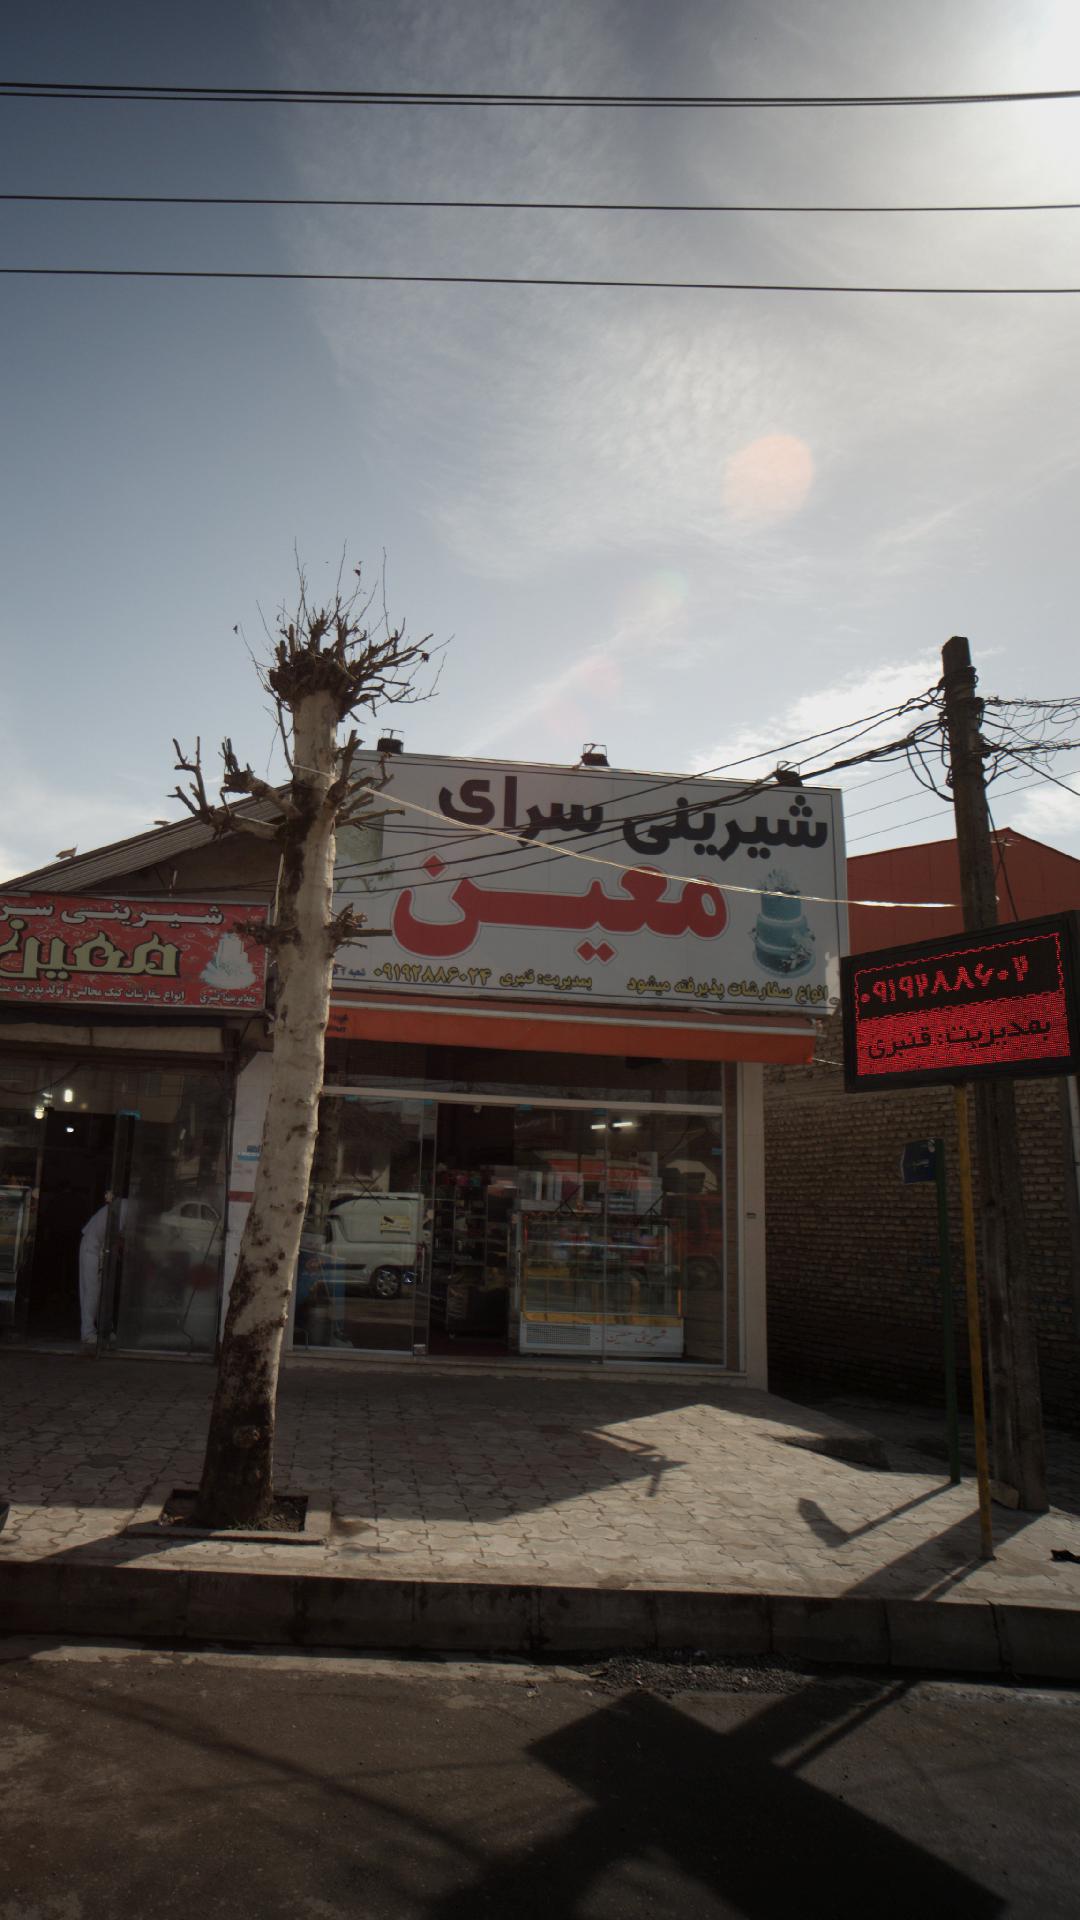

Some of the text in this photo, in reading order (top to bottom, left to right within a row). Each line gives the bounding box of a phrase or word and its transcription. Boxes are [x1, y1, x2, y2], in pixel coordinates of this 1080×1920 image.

[439, 775, 828, 861] شیرینی سرای
[0, 902, 225, 927] شیرینی سر
[392, 852, 729, 963] معین
[373, 962, 493, 986] ۰۹۱۹۲۸۸۶۰۲۴
[499, 968, 535, 987] قنبری
[104, 987, 123, 998] کیک
[626, 975, 829, 1004] انواع سفارشات پذیرفته میشود
[868, 1027, 932, 1060] قنبری
